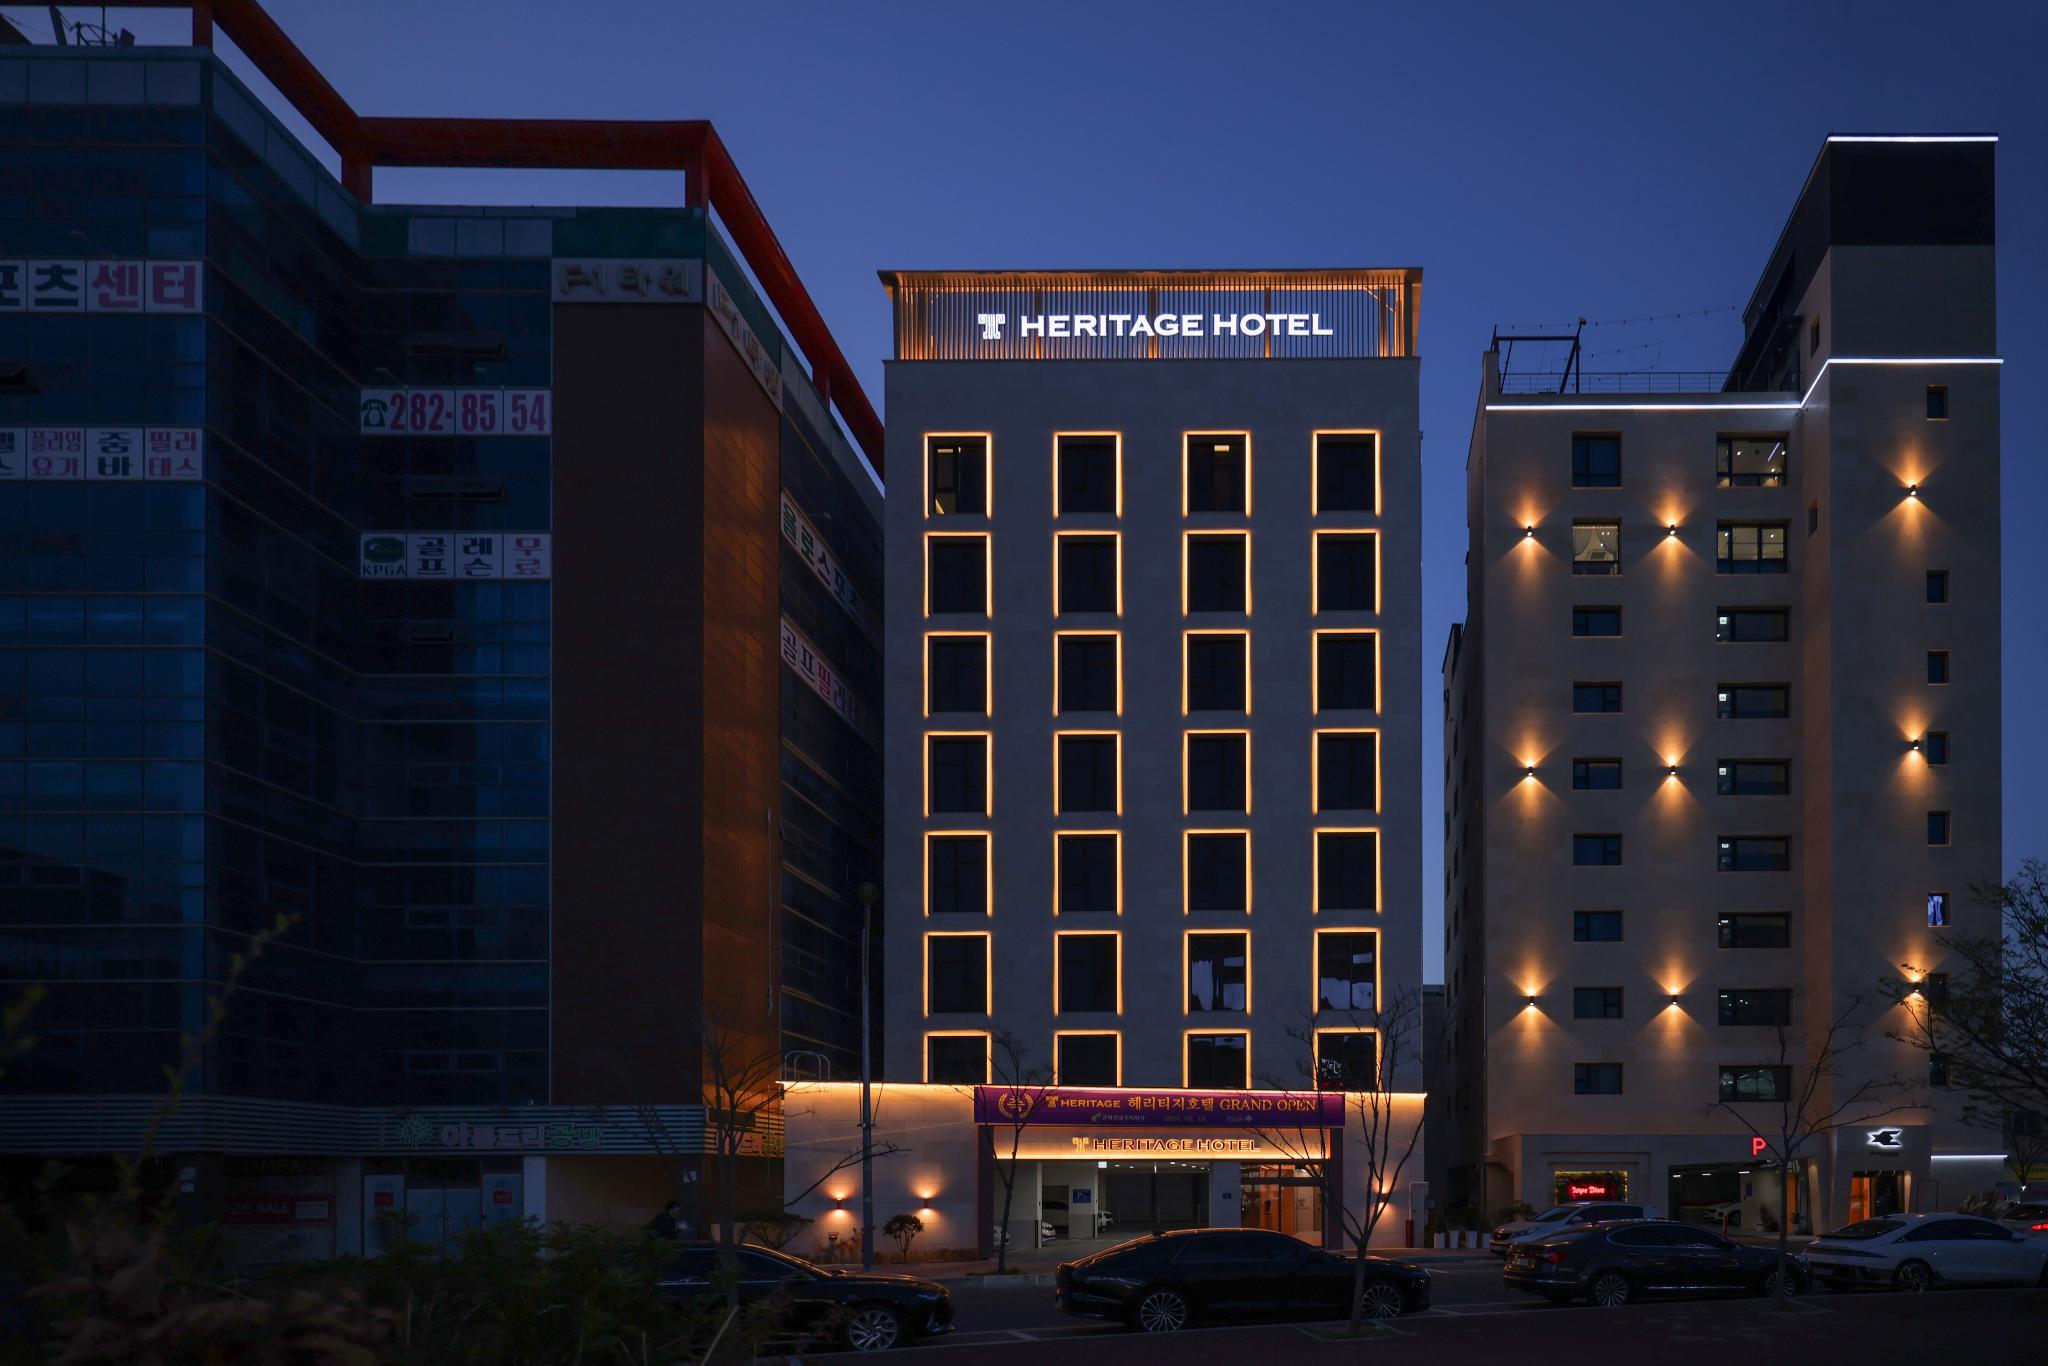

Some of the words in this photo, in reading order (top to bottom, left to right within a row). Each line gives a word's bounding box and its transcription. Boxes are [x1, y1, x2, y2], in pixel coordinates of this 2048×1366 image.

[1020, 313, 1204, 338] HERITAGE
[1212, 313, 1334, 336] HOTEL
[363, 565, 408, 576] KPGA
[1060, 1099, 1121, 1109] HERITAGE
[1127, 1096, 1215, 1112] 헤리티지호텔
[1219, 1099, 1273, 1112] GRAND
[1276, 1099, 1318, 1113] OPEN
[1093, 1138, 1194, 1152] HERITAGE
[1197, 1138, 1262, 1152] HOTEL
[1751, 1136, 1768, 1157] P
